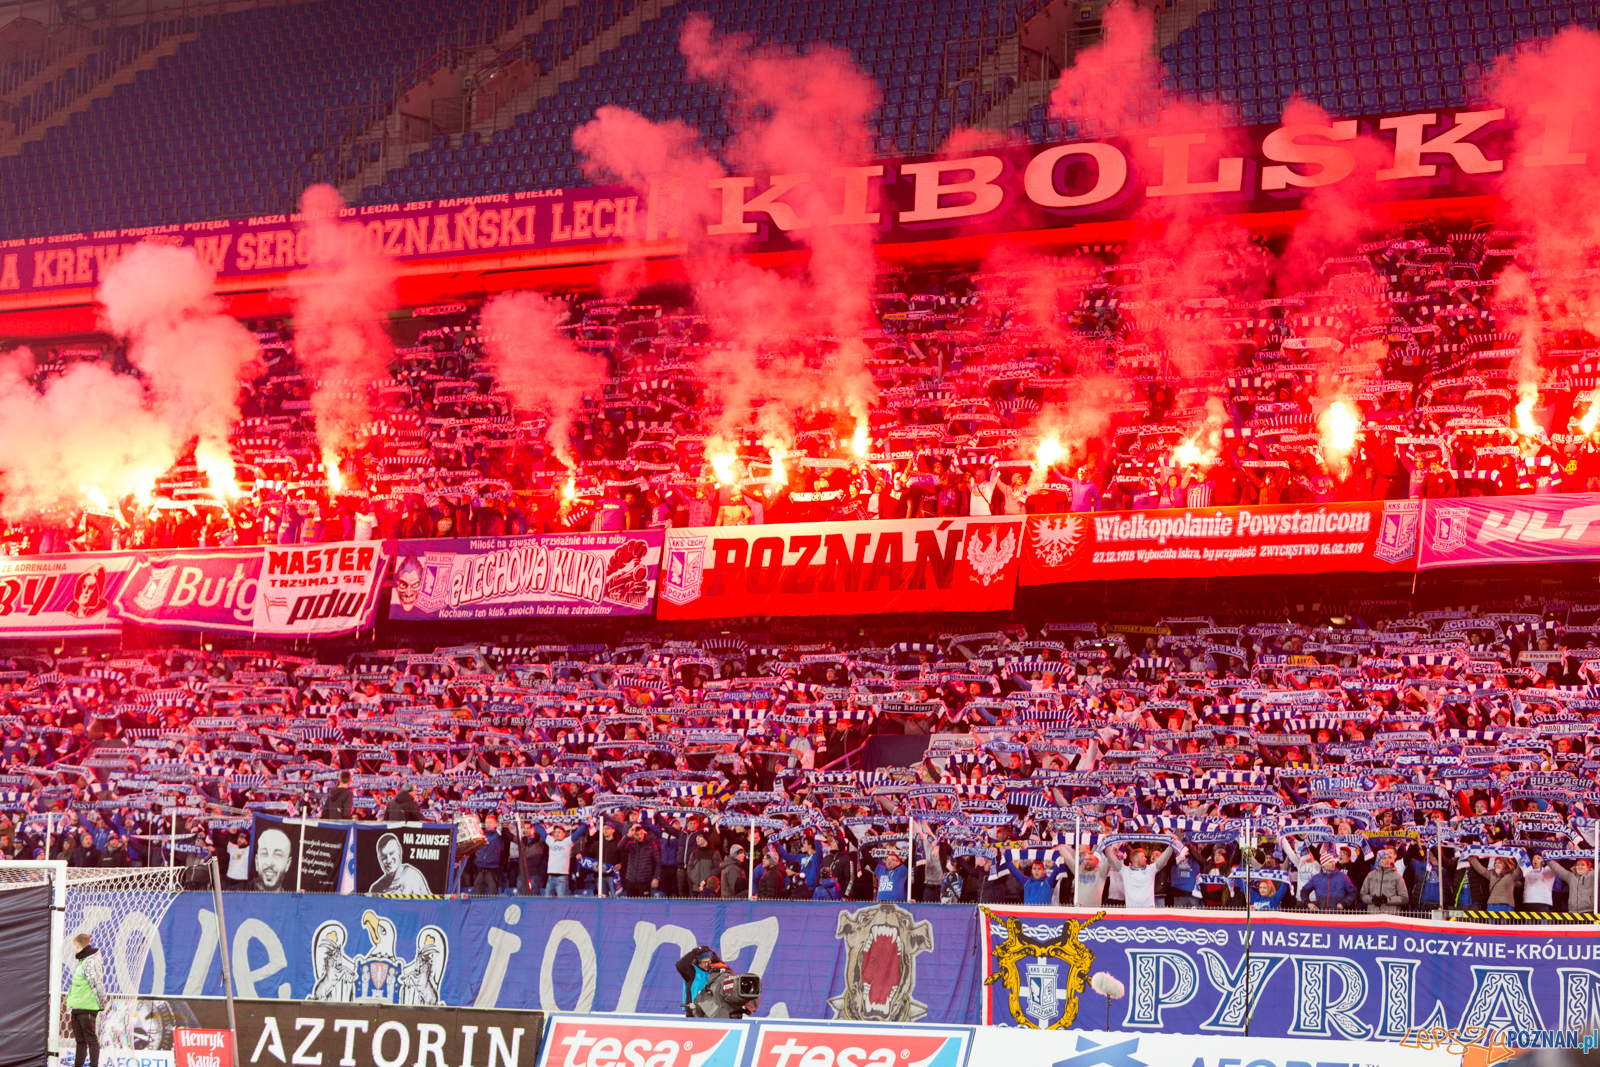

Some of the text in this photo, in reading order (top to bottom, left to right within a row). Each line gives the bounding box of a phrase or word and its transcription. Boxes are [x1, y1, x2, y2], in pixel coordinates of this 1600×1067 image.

[707, 103, 1590, 236] KIBOLSKI
[29, 236, 44, 245] DO
[47, 231, 88, 243] SERCA,
[92, 229, 116, 239] TAM
[120, 223, 180, 237] POWSTAJE
[184, 219, 230, 233] POTĘGA
[248, 215, 286, 227] NASZA
[339, 206, 356, 217] DO
[360, 203, 400, 215] LECHA
[403, 200, 434, 211] JEST
[439, 191, 509, 208] NAPRAWDĘ
[514, 188, 563, 201] WIELKA
[551, 196, 638, 243] LECH
[1093, 507, 1371, 545] Wielkopolanie Powstańcom
[470, 534, 627, 550] Miłość na zawsze, przyjaźnie nie na niby
[1093, 542, 1365, 563] 27.12.1918 Wybuchła iskra, by przynieść ZWYCIĘSTWO 16.02.1919
[15, 562, 67, 572] ADRENALINA
[268, 546, 375, 575] MASTER
[706, 520, 964, 597] POZNAŃ
[270, 576, 338, 589] TRZYMAJ
[552, 546, 606, 602] KLIKA
[439, 604, 612, 619] Kochamy ten klub, swoich ludzi nie zdradzimy
[1530, 714, 1581, 724] KOLEJORZ
[1415, 800, 1449, 809] EJORZ
[403, 833, 450, 846] NA ZAWSZE
[410, 848, 440, 861] Z NAMI
[1239, 930, 1256, 946] W
[1262, 930, 1332, 949] NASZEJ
[1339, 933, 1398, 951] MAŁEJ
[181, 1030, 225, 1050] Henryk
[250, 1016, 526, 1067] AZTORIN
